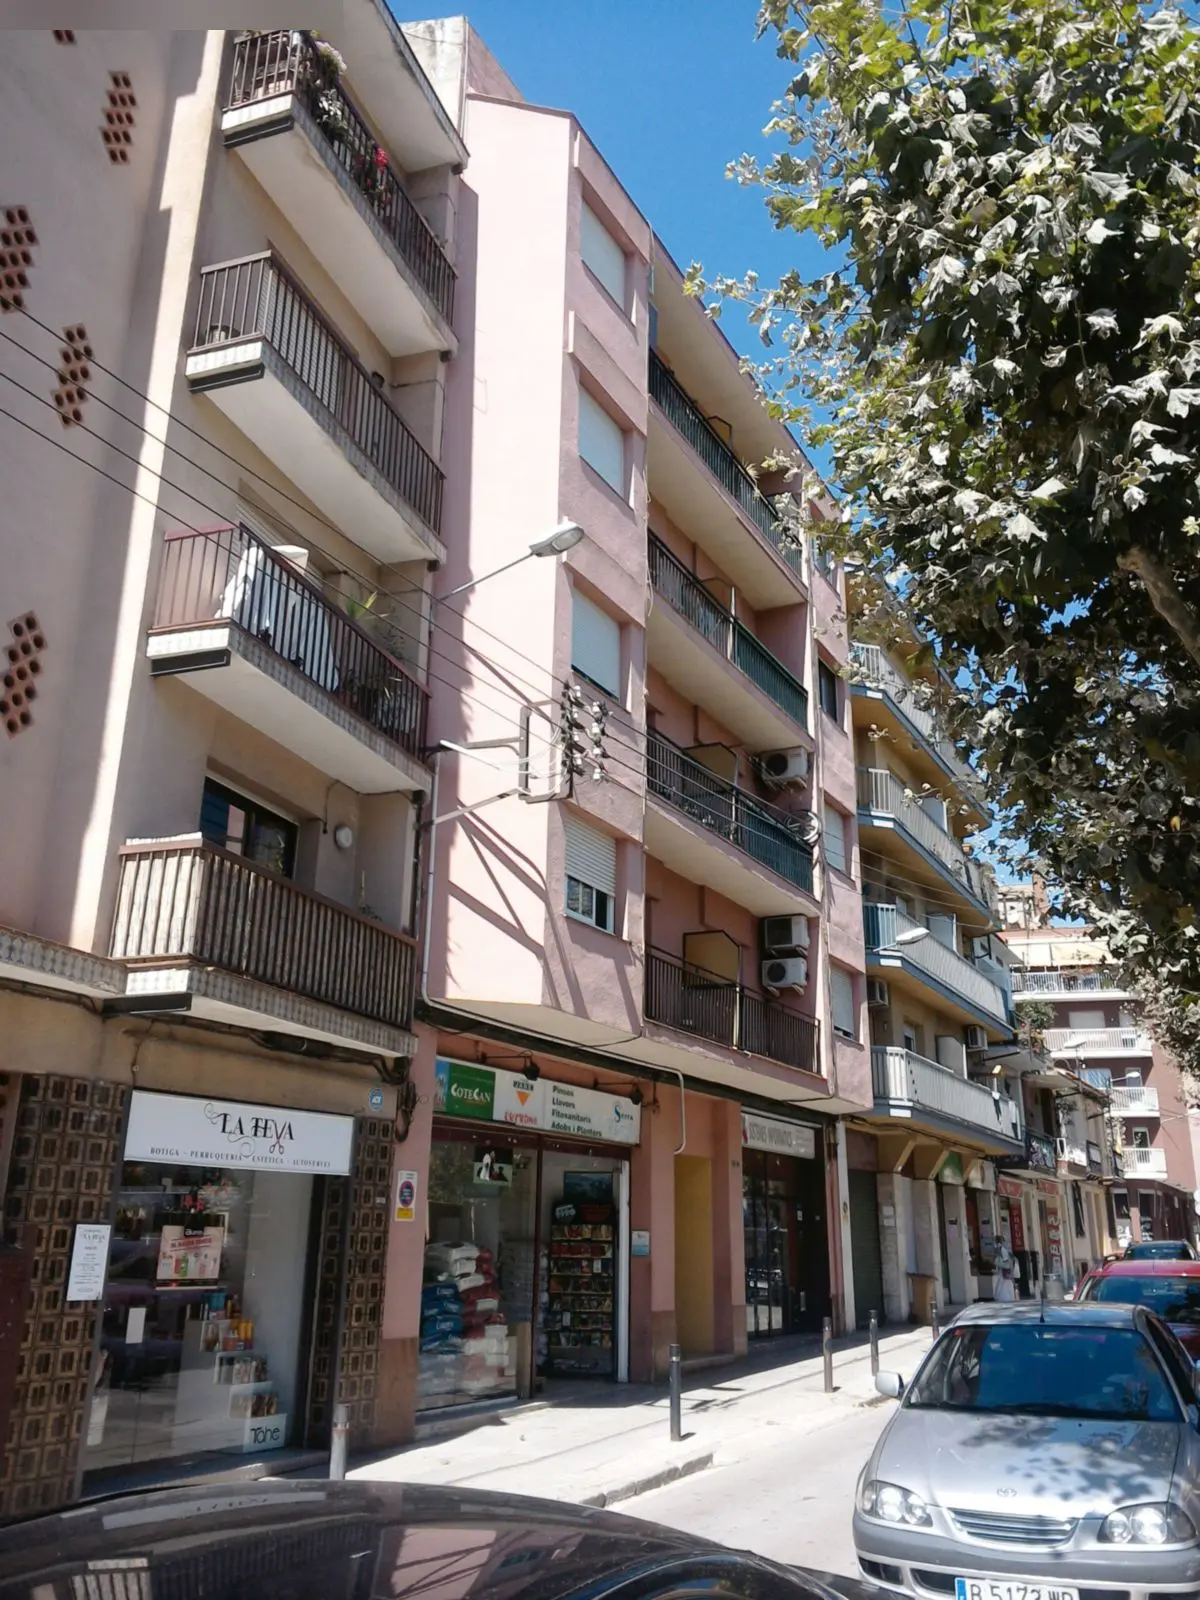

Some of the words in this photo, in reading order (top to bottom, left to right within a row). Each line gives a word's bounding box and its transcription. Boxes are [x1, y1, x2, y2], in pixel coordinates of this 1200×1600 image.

[251, 1117, 295, 1144] TEVA
[150, 1147, 180, 1157] BOTIGA
[190, 1150, 243, 1162] PERRUQUERIA
[970, 1583, 982, 1600] B
